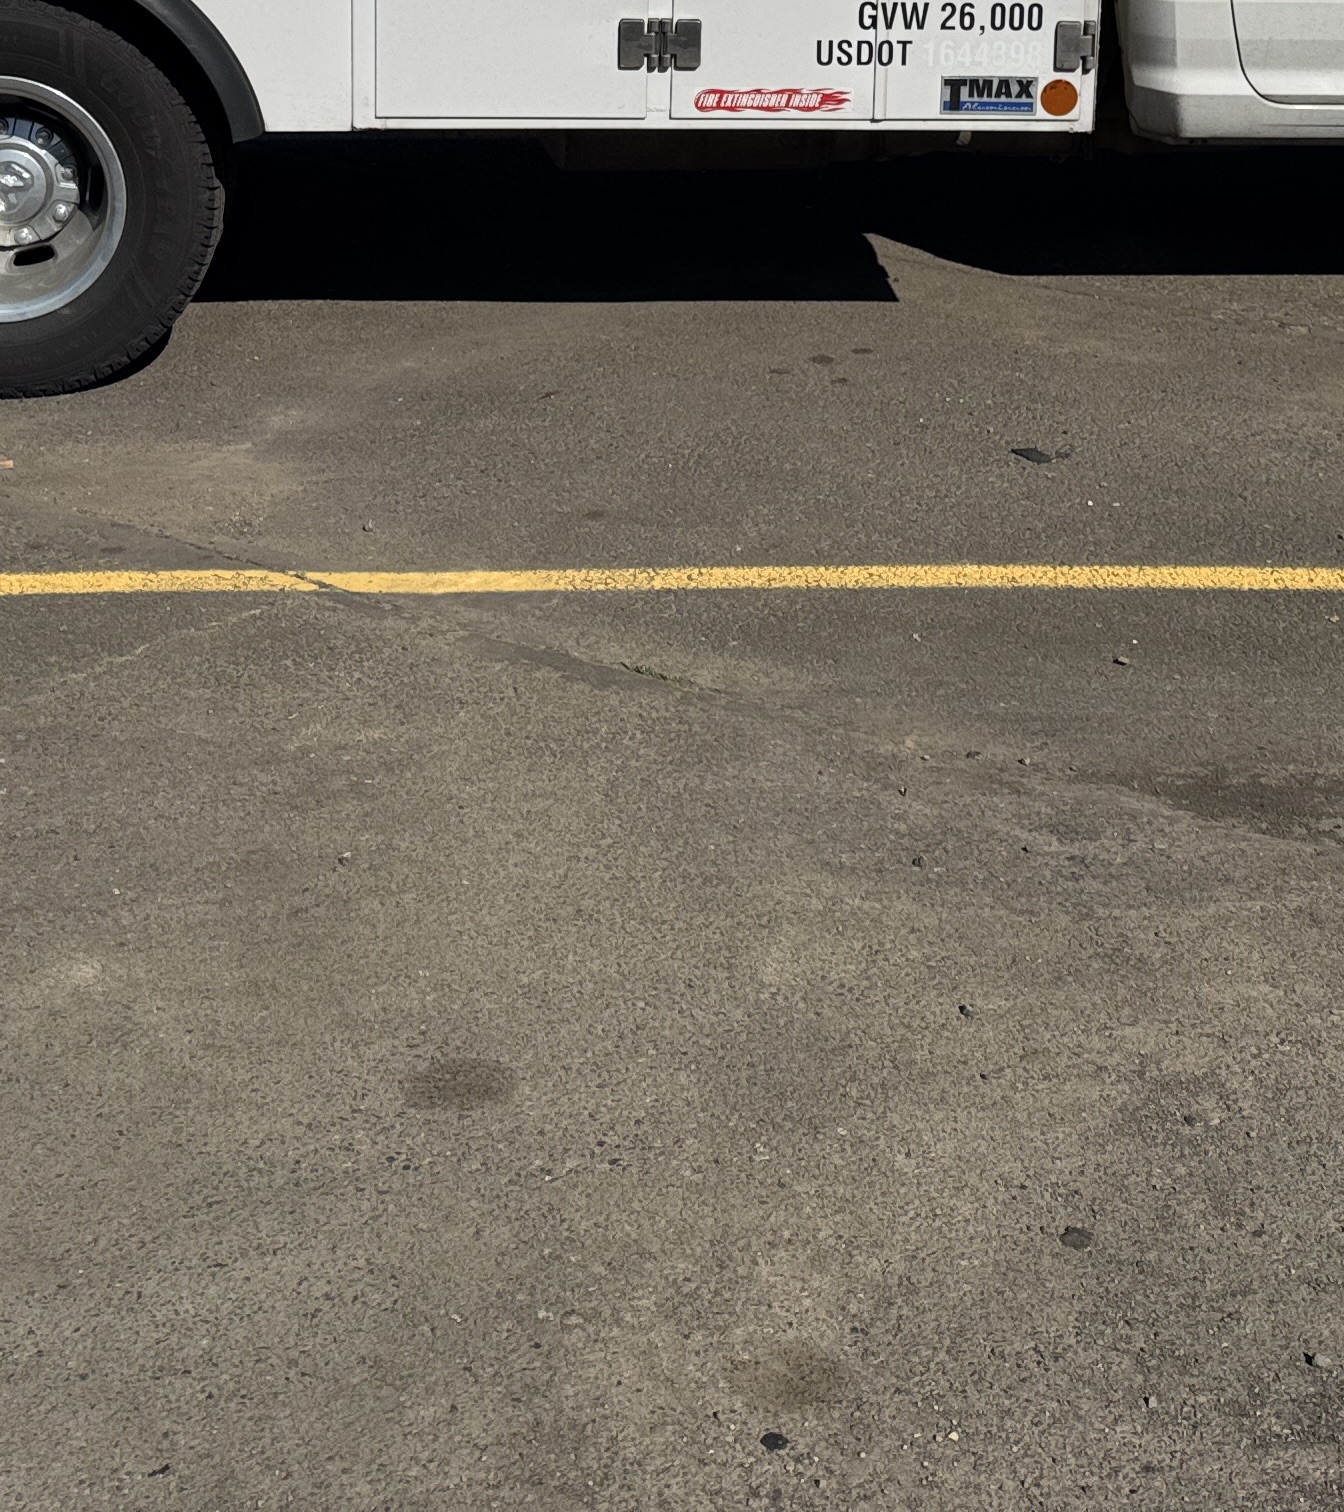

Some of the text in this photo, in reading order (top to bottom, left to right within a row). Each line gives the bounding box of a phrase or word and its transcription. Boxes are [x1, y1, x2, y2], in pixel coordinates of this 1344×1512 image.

[858, 2, 1044, 36] GVW 26,000
[816, 40, 913, 66] USDOT
[697, 93, 824, 107] FIRE EXTINGUISHER INSIDE
[944, 78, 1034, 111] TMAX
